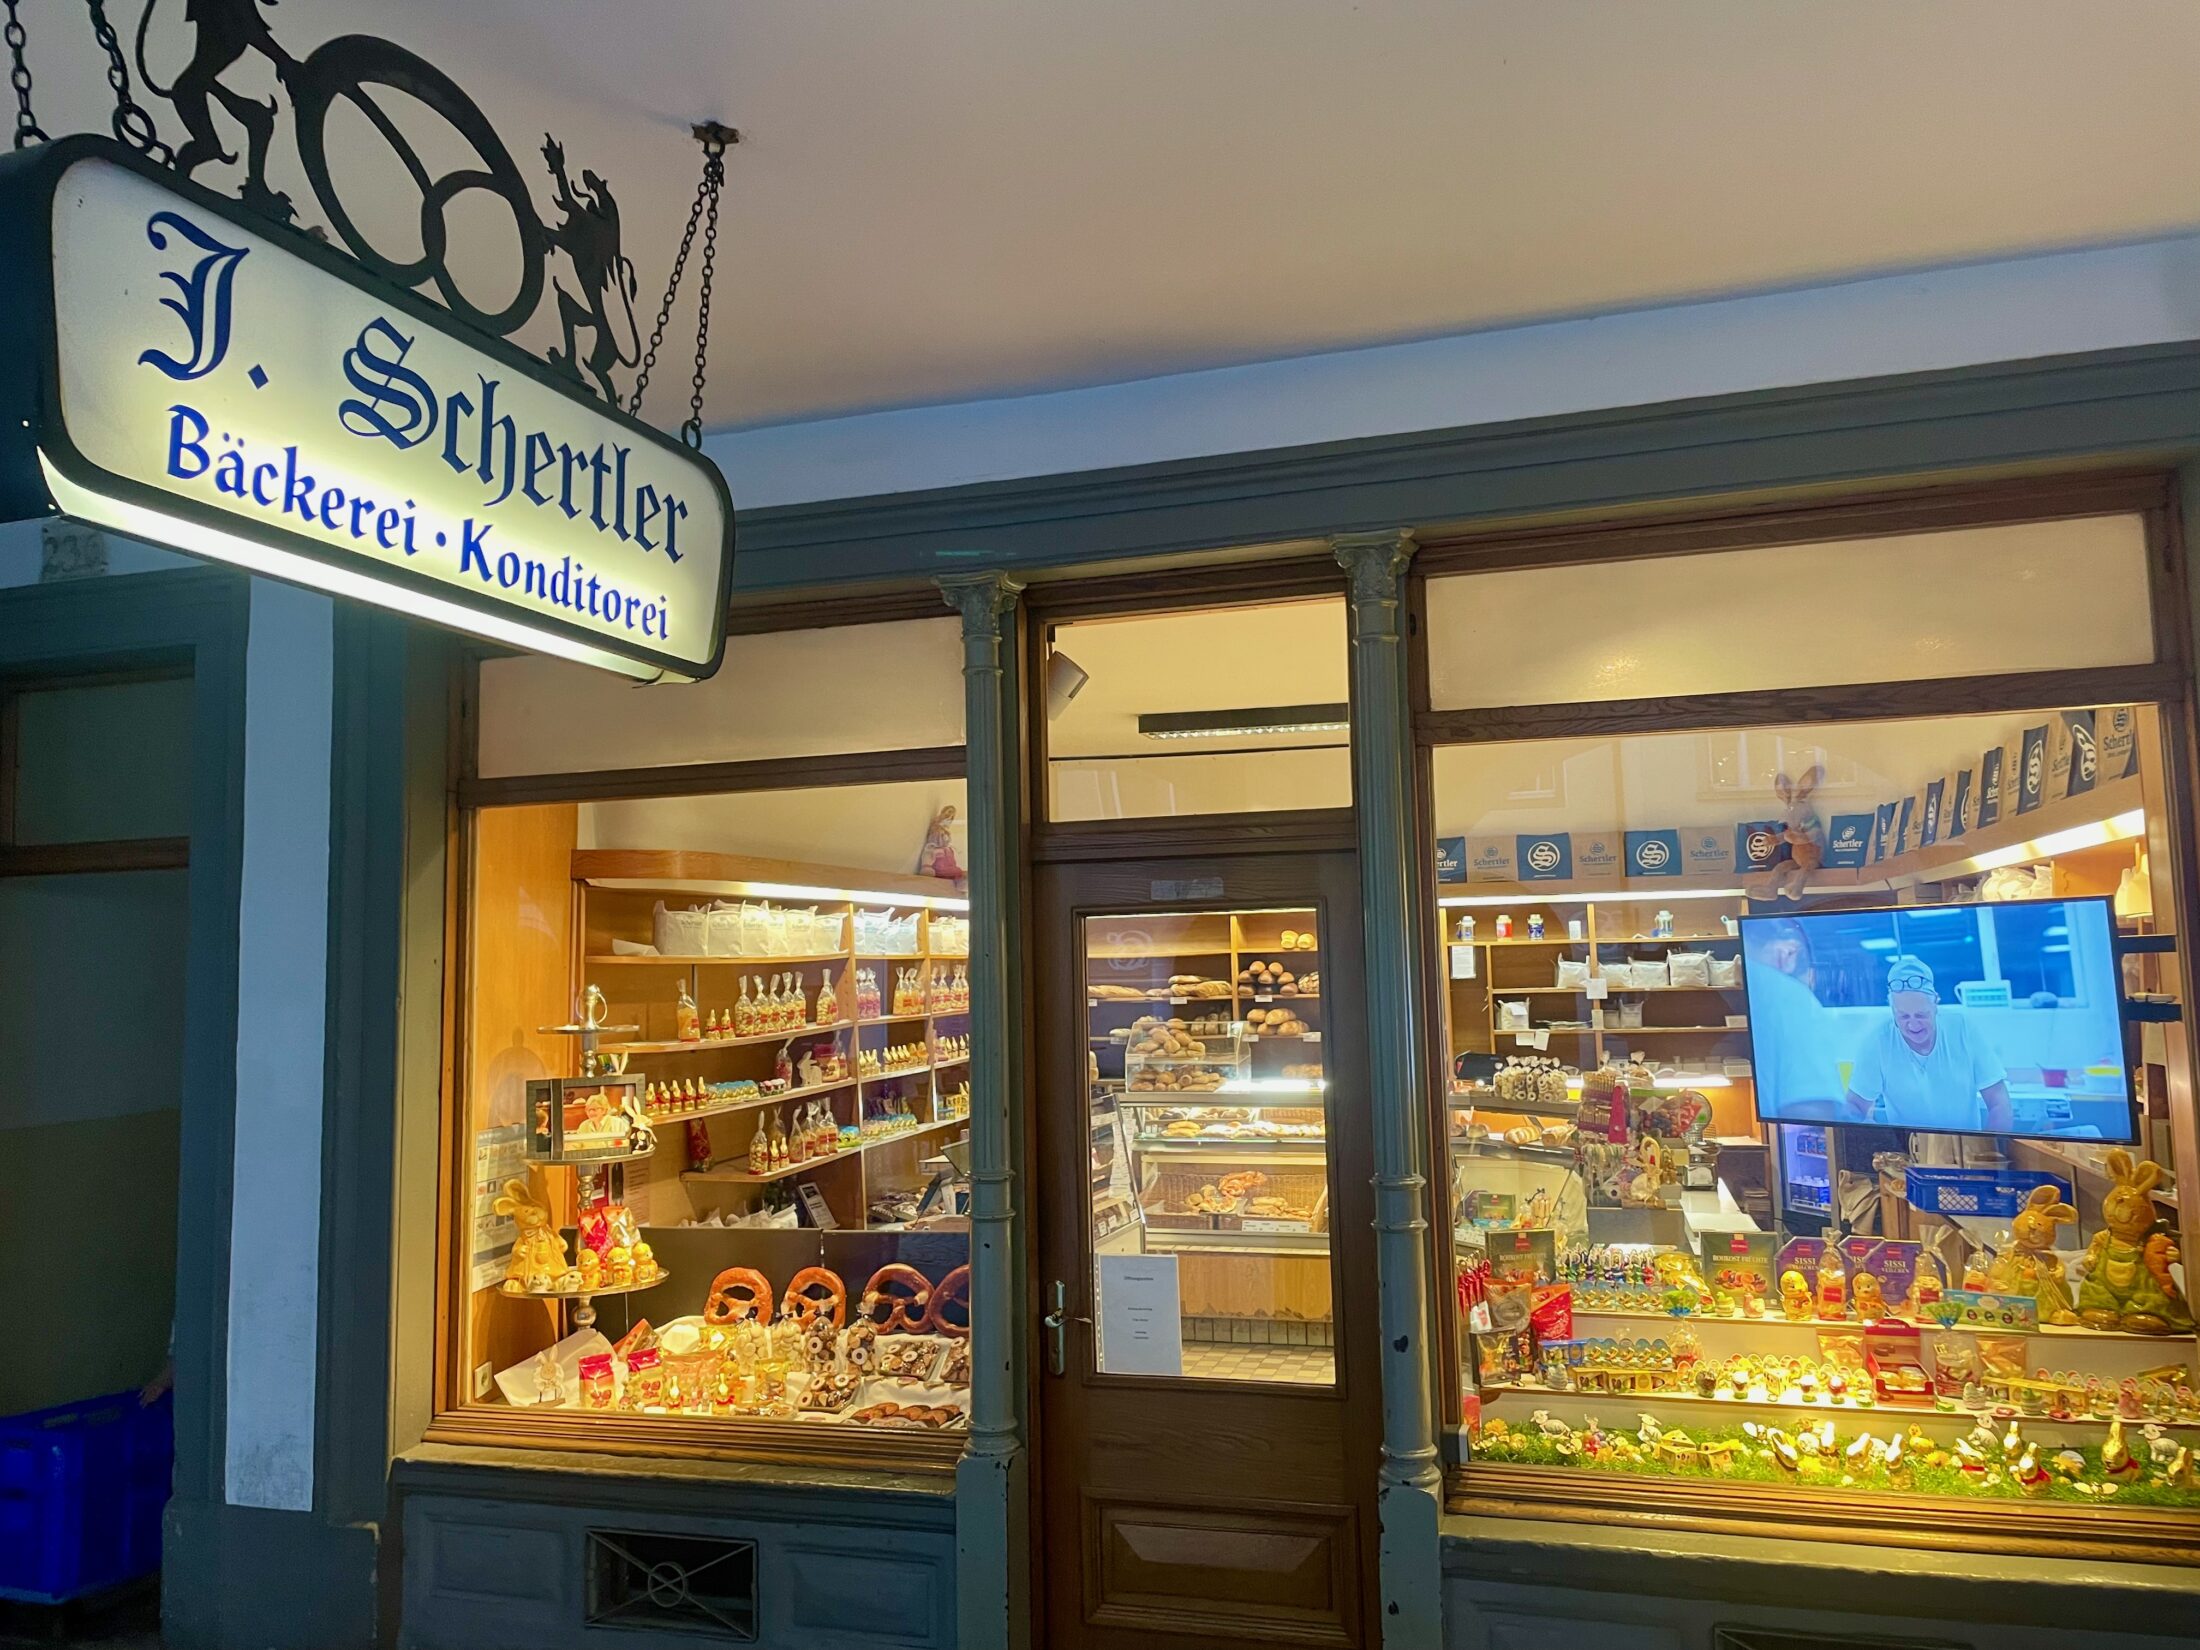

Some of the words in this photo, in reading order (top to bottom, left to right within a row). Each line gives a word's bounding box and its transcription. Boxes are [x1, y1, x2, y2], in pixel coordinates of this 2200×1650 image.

[338, 316, 688, 562] Schertler
[166, 403, 418, 557] Bäckerei
[459, 517, 669, 641] Konditorei
[1530, 843, 1558, 870] S
[1639, 843, 1668, 867] S
